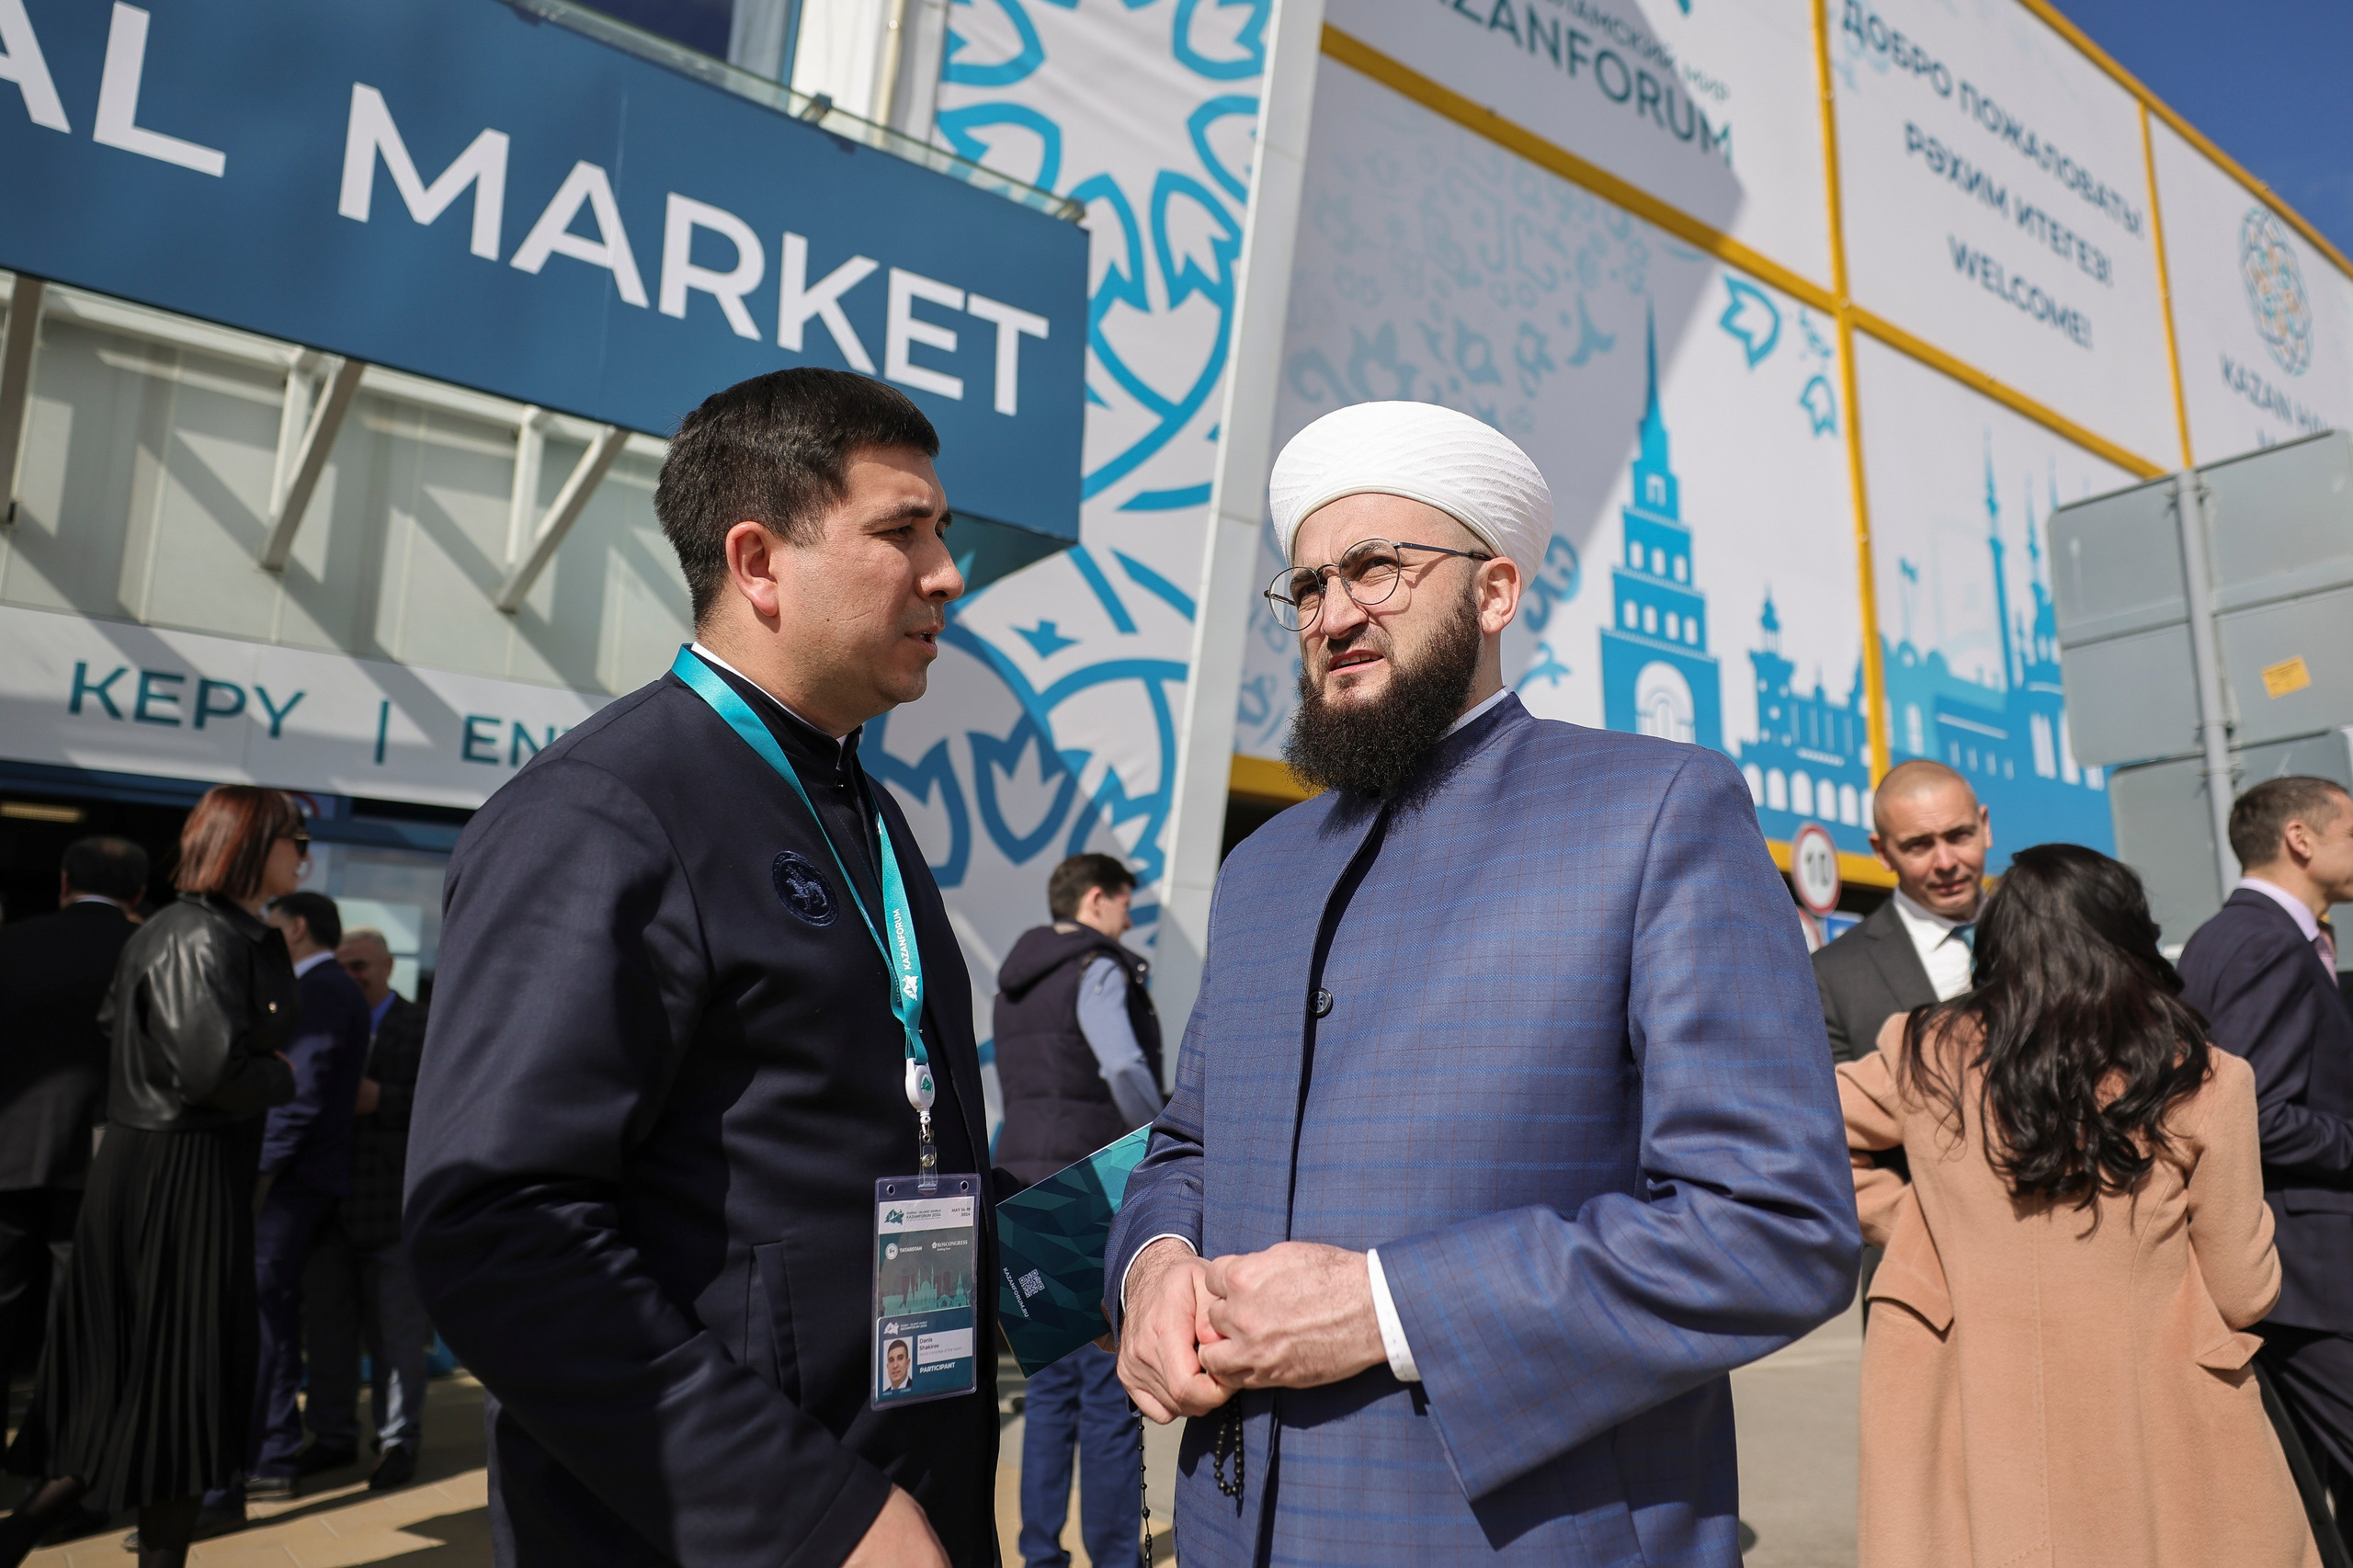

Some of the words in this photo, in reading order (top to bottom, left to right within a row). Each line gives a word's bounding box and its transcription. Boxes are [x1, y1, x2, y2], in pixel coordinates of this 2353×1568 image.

[1843, 0, 1953, 98] ДОБРО
[338, 82, 1050, 416] MARKET
[1947, 233, 2094, 349] WELCOME!
[461, 713, 573, 768] EN
[892, 908, 913, 971] KAZANFORUM
[1003, 1267, 1029, 1317] KAZANFORUM.RU
[919, 1362, 955, 1373] PARTICIPANT
